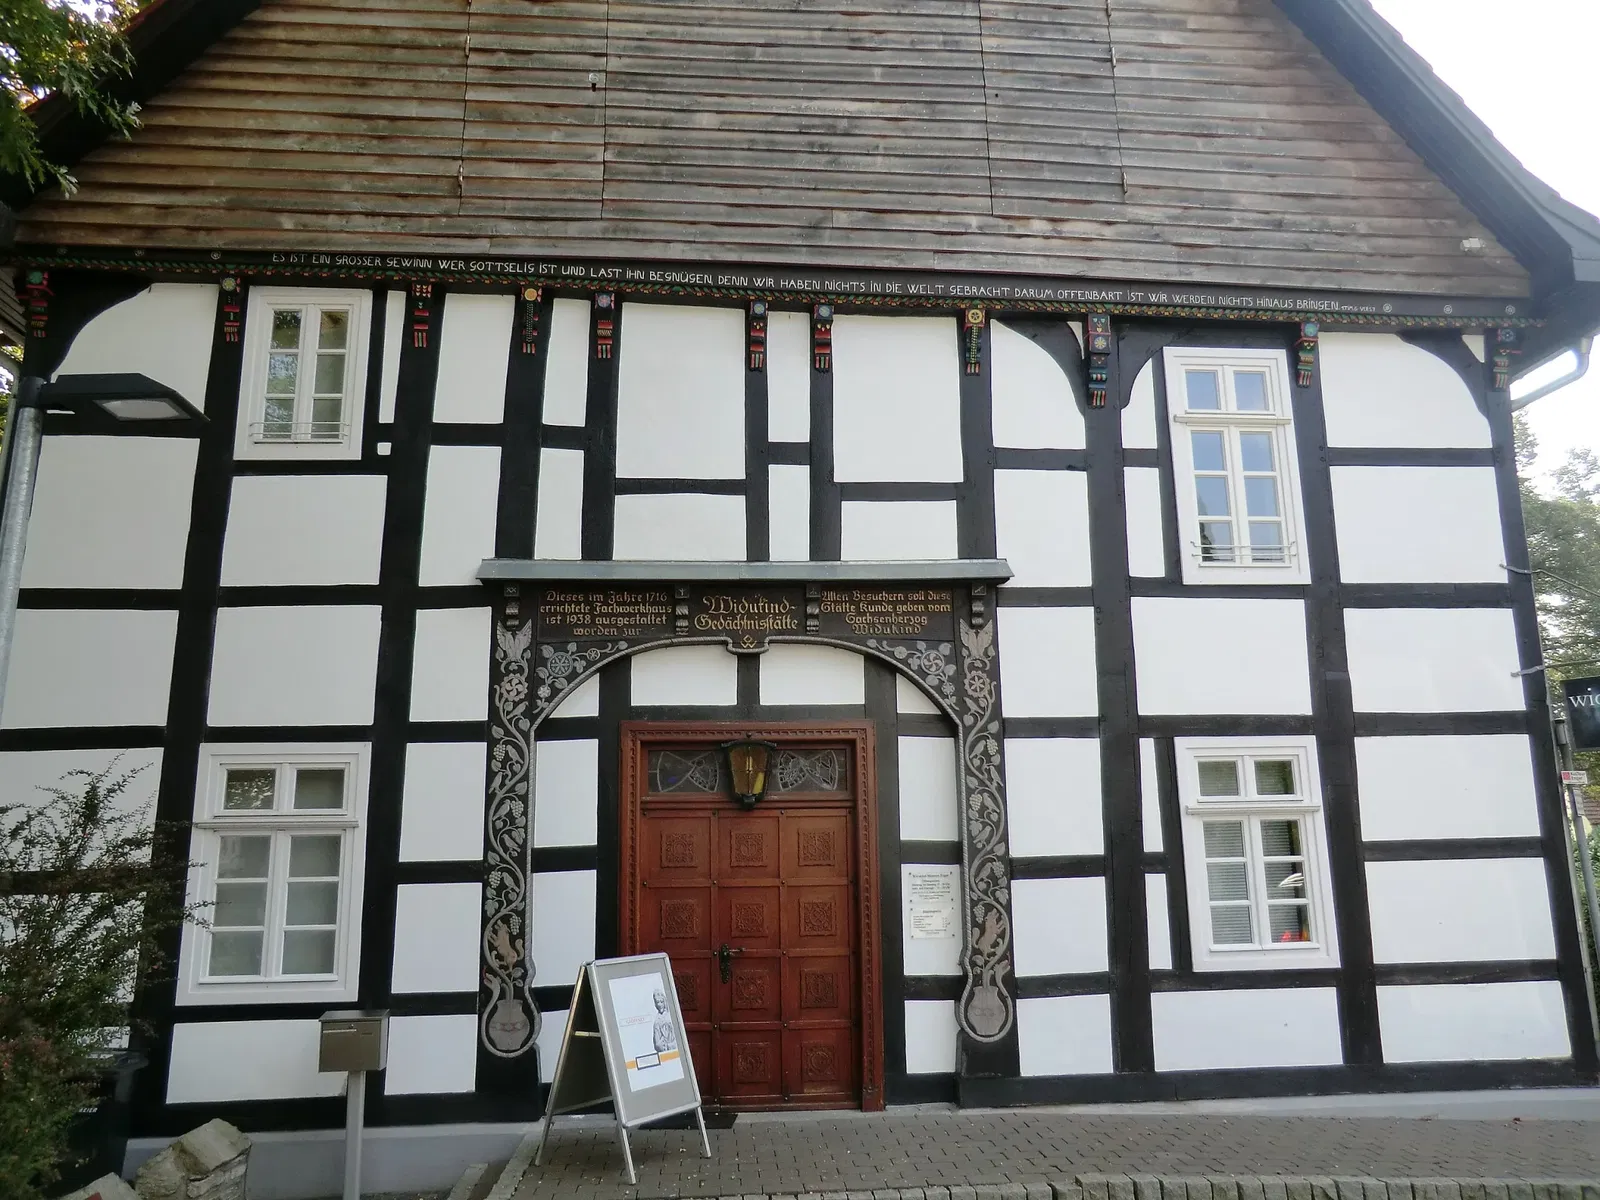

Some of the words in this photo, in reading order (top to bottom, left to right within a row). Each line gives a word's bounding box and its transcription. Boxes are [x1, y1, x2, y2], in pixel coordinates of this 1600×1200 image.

[272, 254, 286, 262] ES
[290, 254, 307, 263] IST
[312, 254, 330, 264] EIN
[335, 255, 382, 267] GROSSER
[386, 256, 432, 268] GEWINN
[438, 259, 466, 270] WER
[470, 260, 535, 274] GOTTSELIG
[539, 262, 557, 274] IST
[562, 265, 586, 276] UND
[590, 268, 622, 279] LAST
[626, 268, 645, 280] IHN
[718, 275, 748, 286] DENN
[752, 276, 774, 288] WIR
[780, 279, 820, 290] HABEN
[824, 280, 866, 292] NICHTS
[870, 280, 882, 292] IN
[886, 282, 902, 293] DIE
[907, 284, 944, 295] WELT
[950, 284, 1010, 297] GEBRACHT
[1014, 288, 1054, 299] DARUM
[1057, 289, 1122, 300] OFFENBART
[1127, 290, 1144, 302] IST
[1148, 290, 1168, 303] WIR
[1172, 294, 1215, 305] WERDEN
[1218, 294, 1253, 306] NICHTS
[1256, 296, 1294, 308] HINAUS
[546, 590, 584, 601] Dieses
[588, 591, 604, 601] im
[608, 590, 642, 604] Jahre
[646, 592, 668, 601] 1716
[822, 590, 848, 601] Allen
[852, 590, 904, 601] Besuchern
[908, 591, 924, 601] soll
[928, 590, 951, 600] diese
[540, 602, 590, 614] errichtete
[593, 603, 672, 614] Fachwerkhaus
[821, 602, 856, 613] Stätte
[860, 602, 893, 612] Kunde
[896, 602, 925, 614] geben
[928, 603, 951, 612] vom
[546, 615, 562, 624] ist
[566, 614, 592, 624] 1938
[595, 614, 667, 626] ausgestaltet
[845, 612, 928, 626] Sachsenherzog
[573, 625, 618, 636] worden
[622, 627, 642, 636] zur
[852, 624, 921, 635] Widukind
